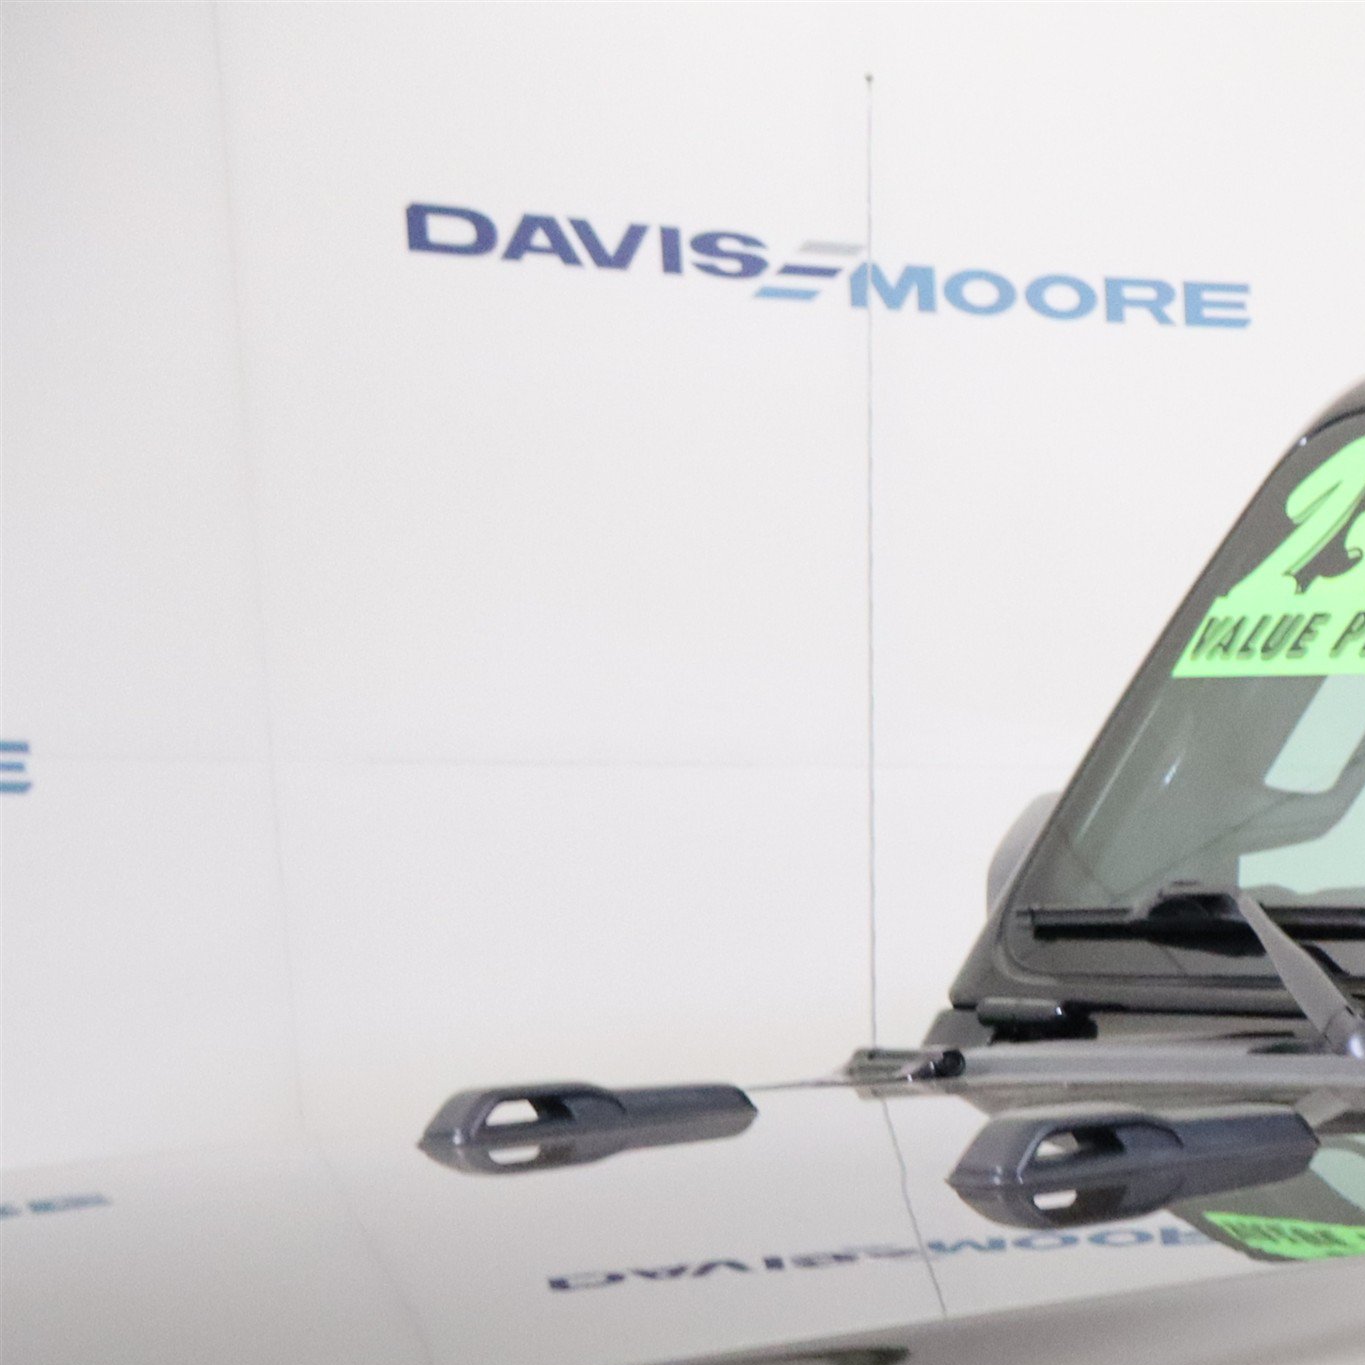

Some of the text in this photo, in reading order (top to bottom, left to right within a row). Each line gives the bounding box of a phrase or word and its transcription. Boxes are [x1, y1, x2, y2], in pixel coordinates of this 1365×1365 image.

[406, 203, 1252, 329] DAVIS MOORE
[1190, 611, 1332, 661] VALUE
